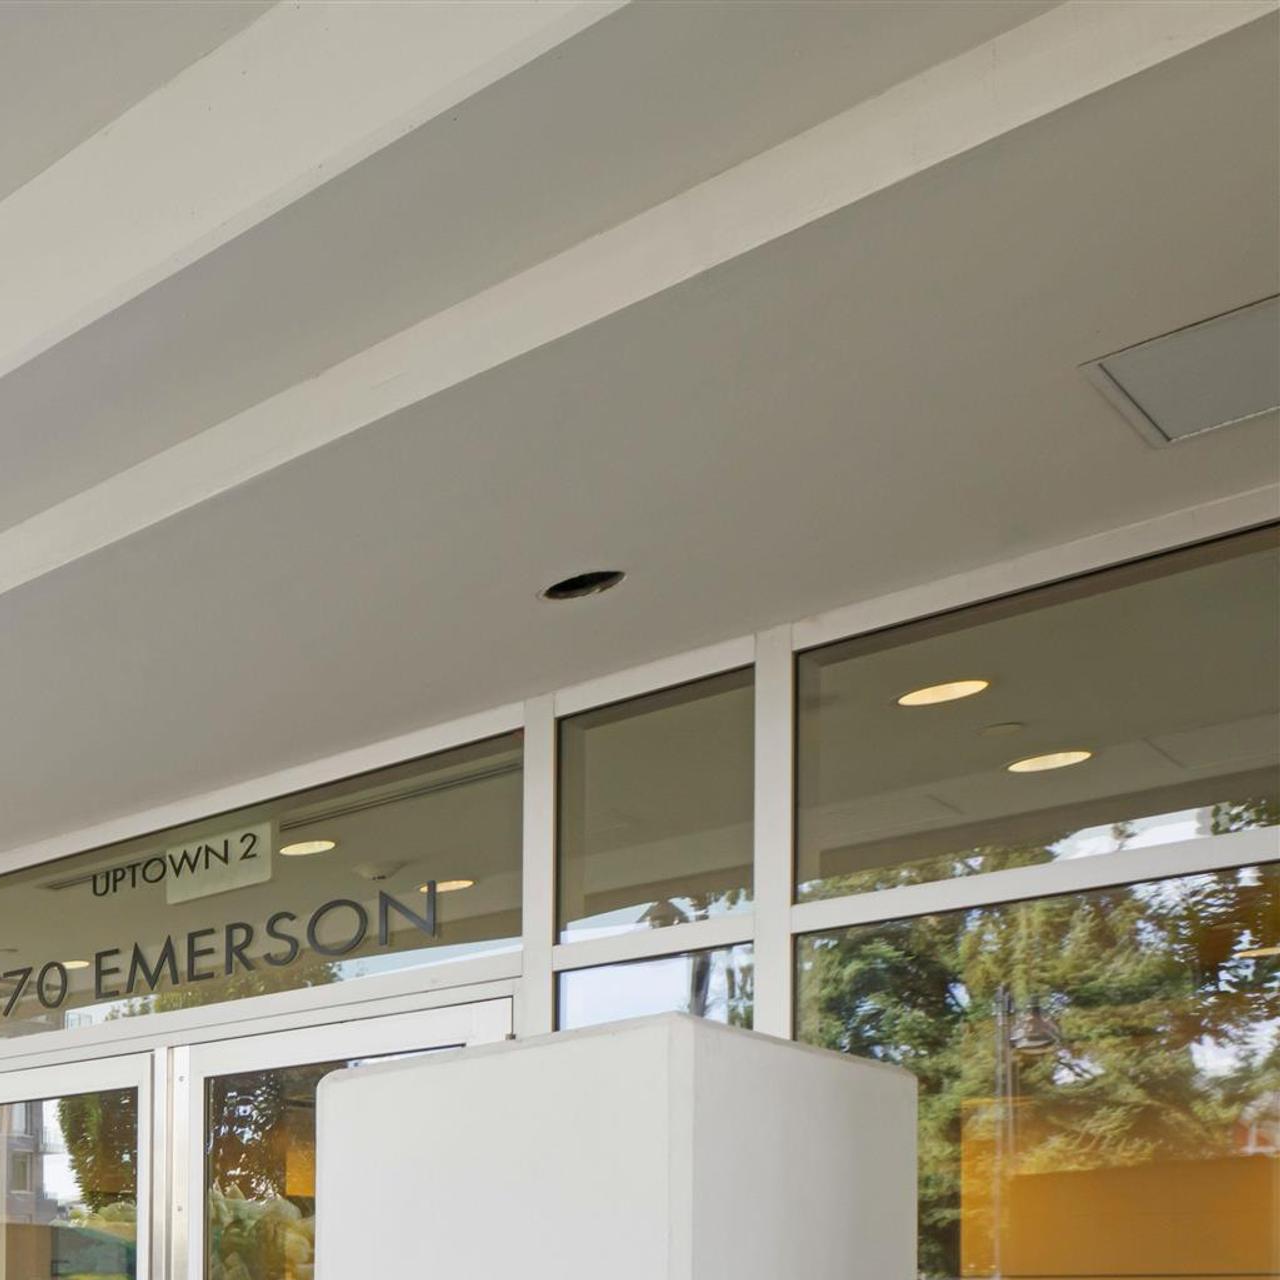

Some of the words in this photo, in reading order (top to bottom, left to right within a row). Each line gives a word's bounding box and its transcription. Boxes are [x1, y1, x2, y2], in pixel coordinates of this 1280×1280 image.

[92, 839, 229, 897] UPTOWN
[240, 832, 258, 861] 2
[94, 880, 437, 1000] EMERSON
